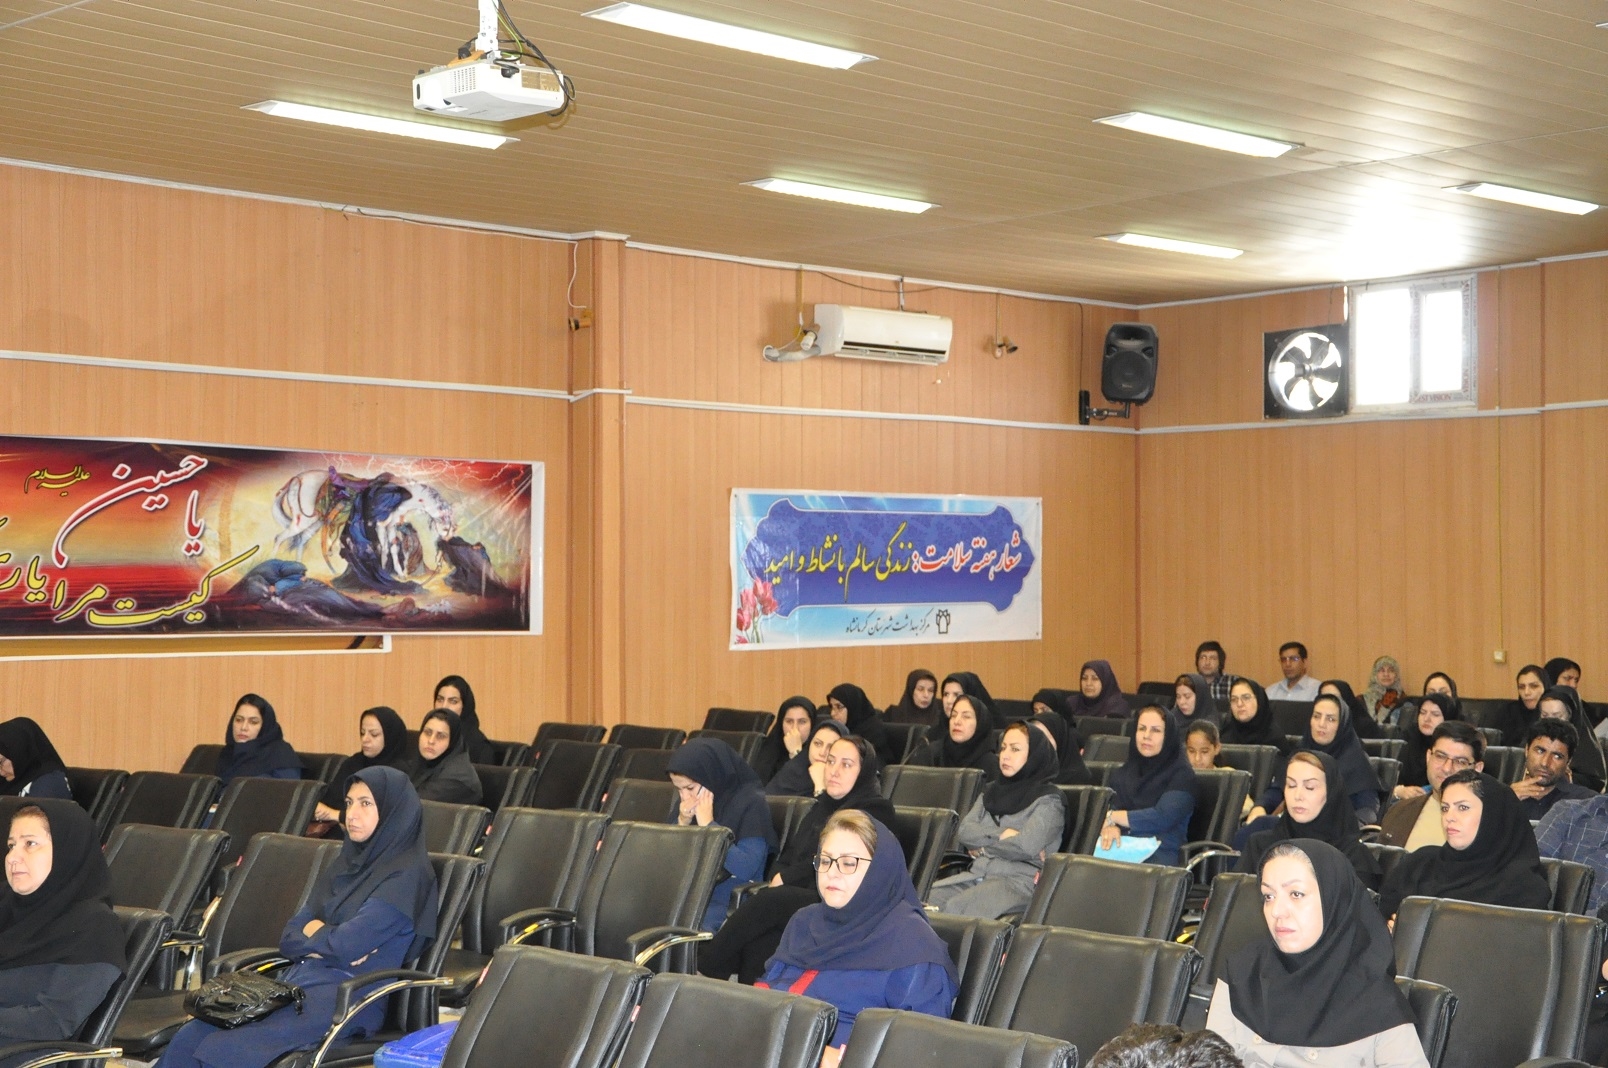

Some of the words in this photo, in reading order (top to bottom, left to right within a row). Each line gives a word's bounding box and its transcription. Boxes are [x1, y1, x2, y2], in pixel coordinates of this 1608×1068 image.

[52, 454, 208, 569] حسین
[182, 490, 206, 555] یا
[763, 549, 794, 585] امید
[795, 555, 805, 573] و
[844, 542, 875, 603] سالم
[875, 521, 912, 581] زندگی
[912, 540, 973, 573] سلامت:
[970, 536, 997, 581] هفته
[993, 530, 1022, 573] شعار
[53, 579, 107, 622] مرا
[87, 545, 260, 626] کیست
[845, 608, 877, 633] کرمانشاه
[867, 615, 893, 636] شهرستان
[892, 613, 920, 636] بهداشت
[919, 607, 935, 634] مرکز
